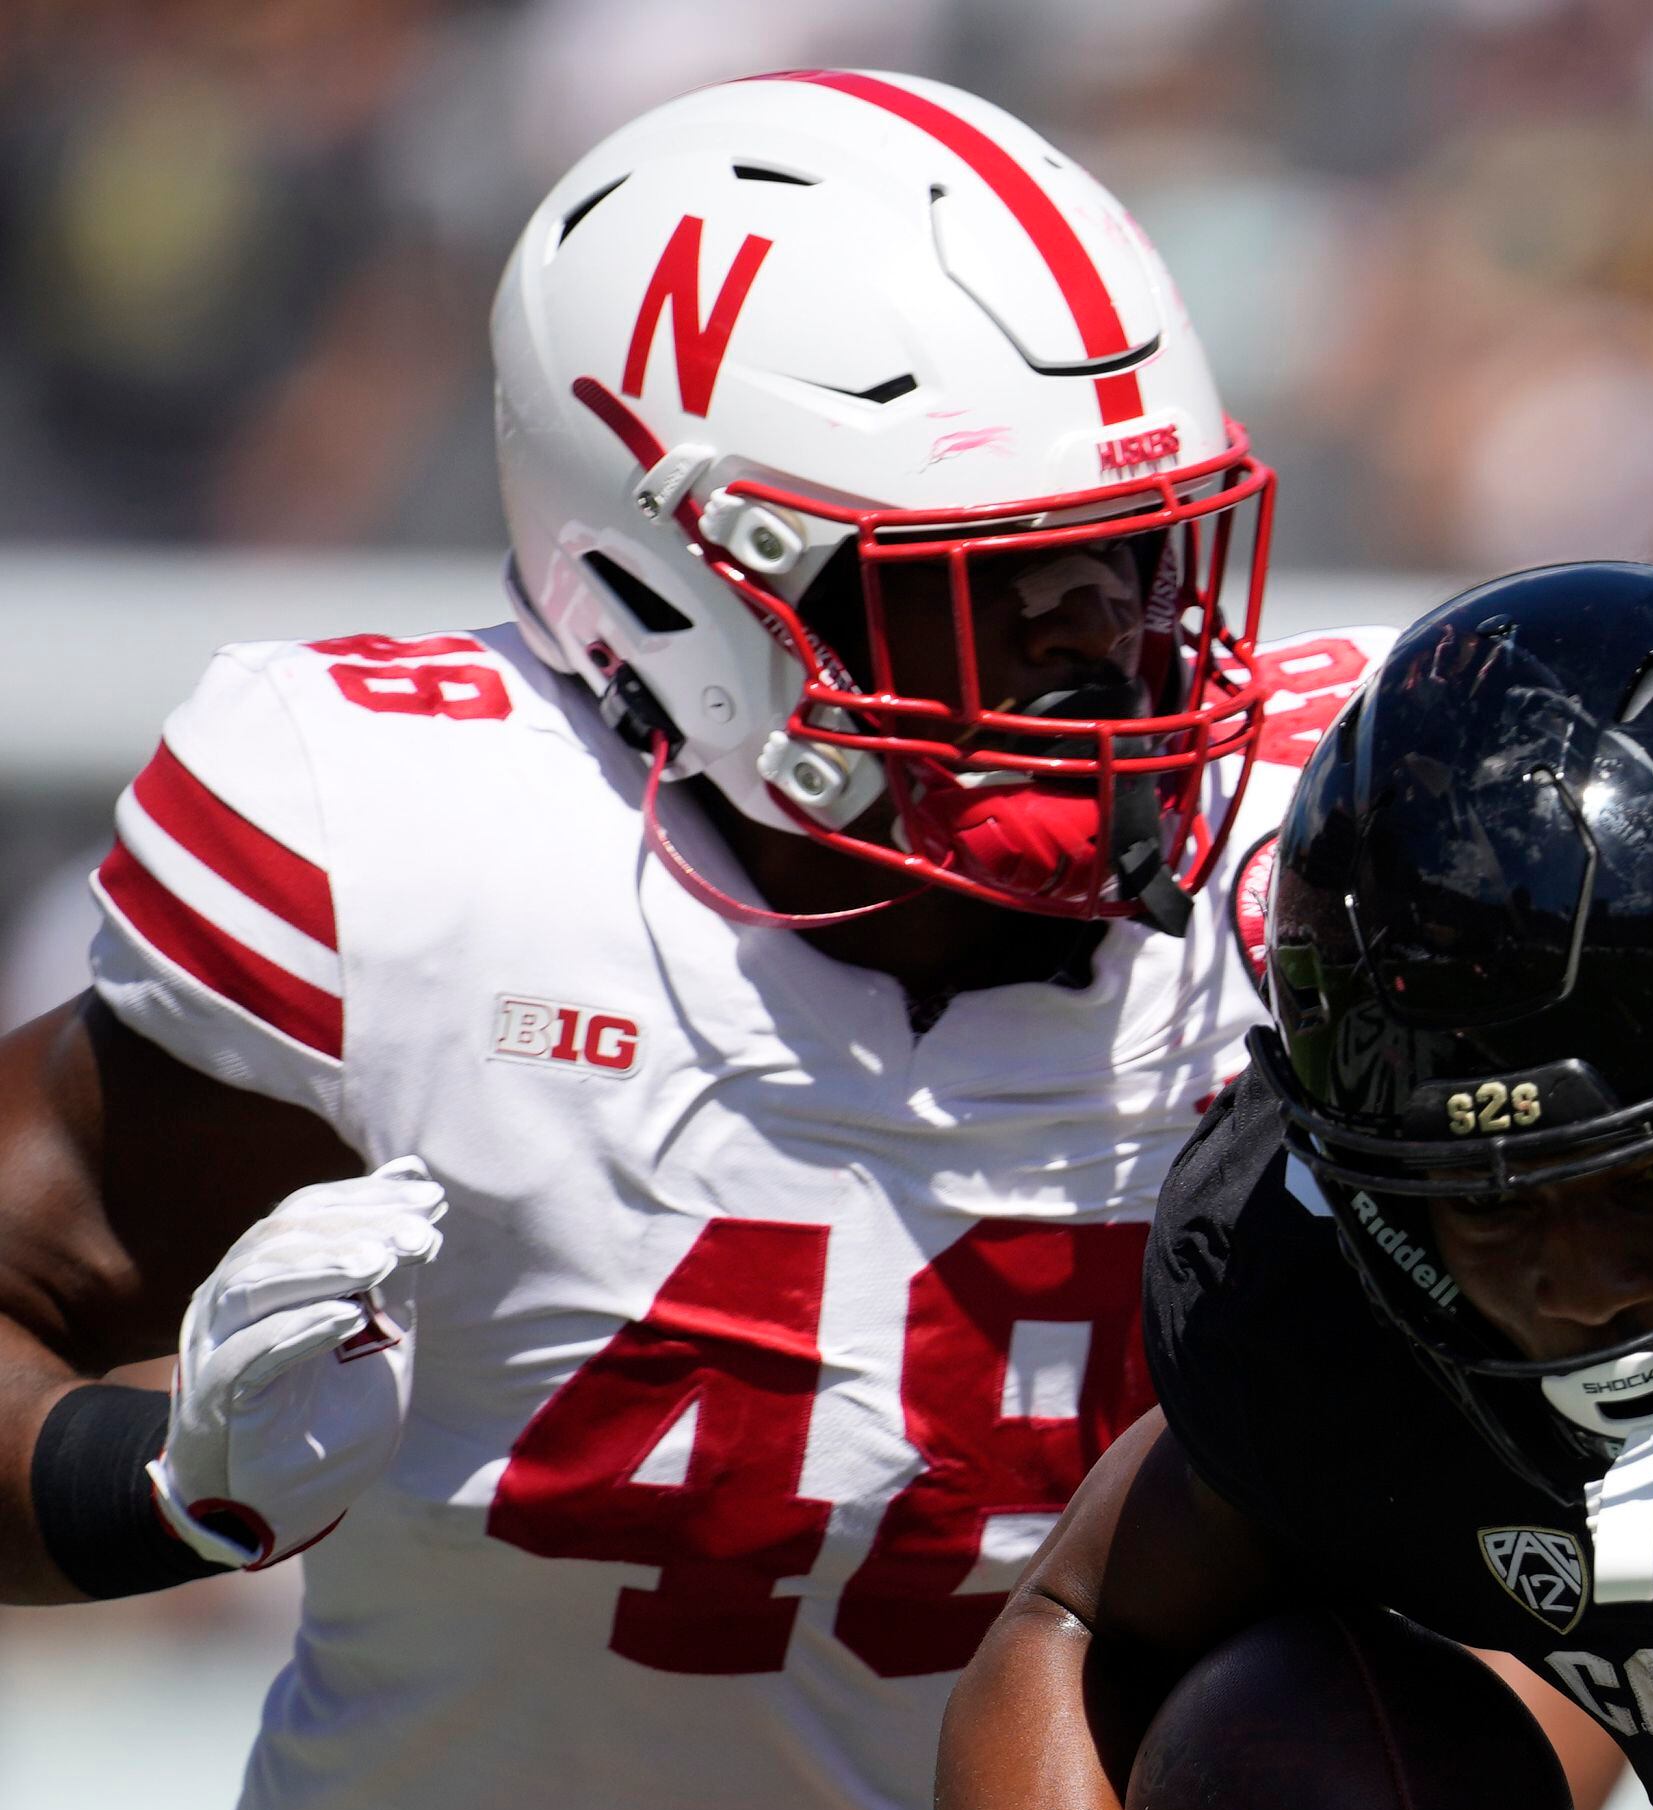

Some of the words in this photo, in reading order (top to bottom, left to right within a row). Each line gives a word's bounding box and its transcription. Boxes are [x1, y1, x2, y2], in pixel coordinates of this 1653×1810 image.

[620, 214, 773, 418] N
[1350, 1190, 1460, 1308] Riddell
[485, 1216, 1160, 1679] 48
[1485, 1531, 1581, 1596] PAC
[1519, 1573, 1575, 1613] 12
